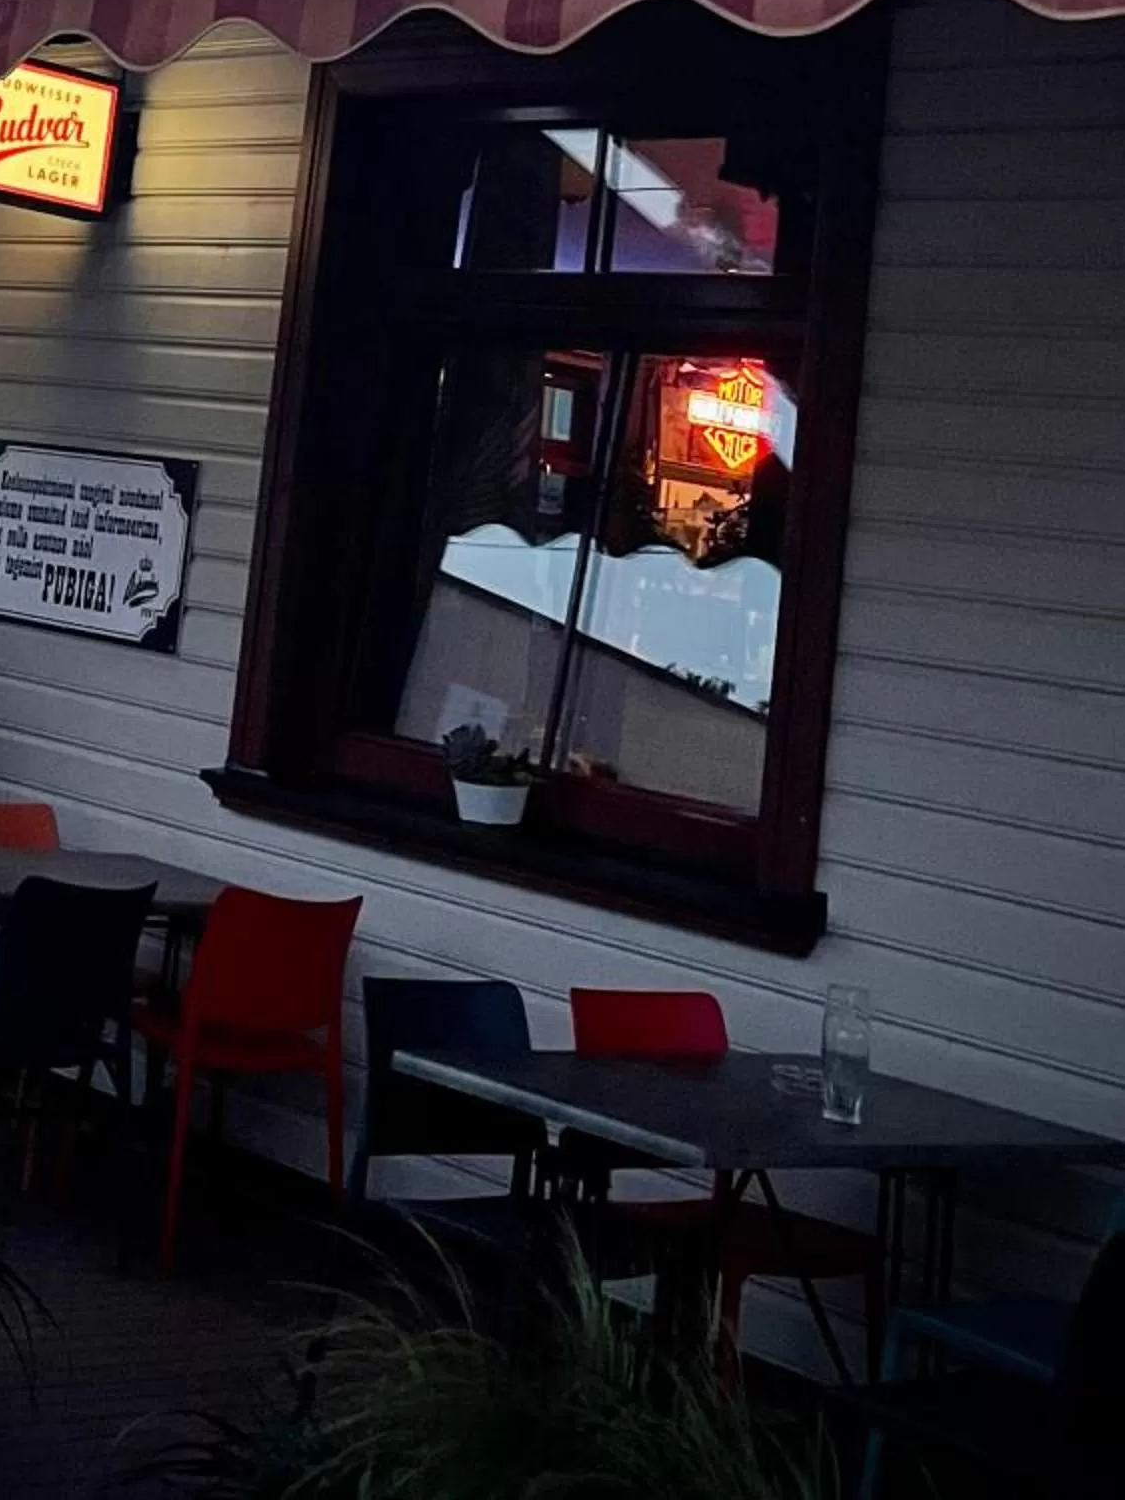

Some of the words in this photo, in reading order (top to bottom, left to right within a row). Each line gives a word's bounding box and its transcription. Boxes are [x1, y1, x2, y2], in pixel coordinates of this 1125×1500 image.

[2, 78, 83, 105] UDWEISER
[27, 165, 80, 188] LAGER
[41, 562, 116, 614] PUBIGA!
